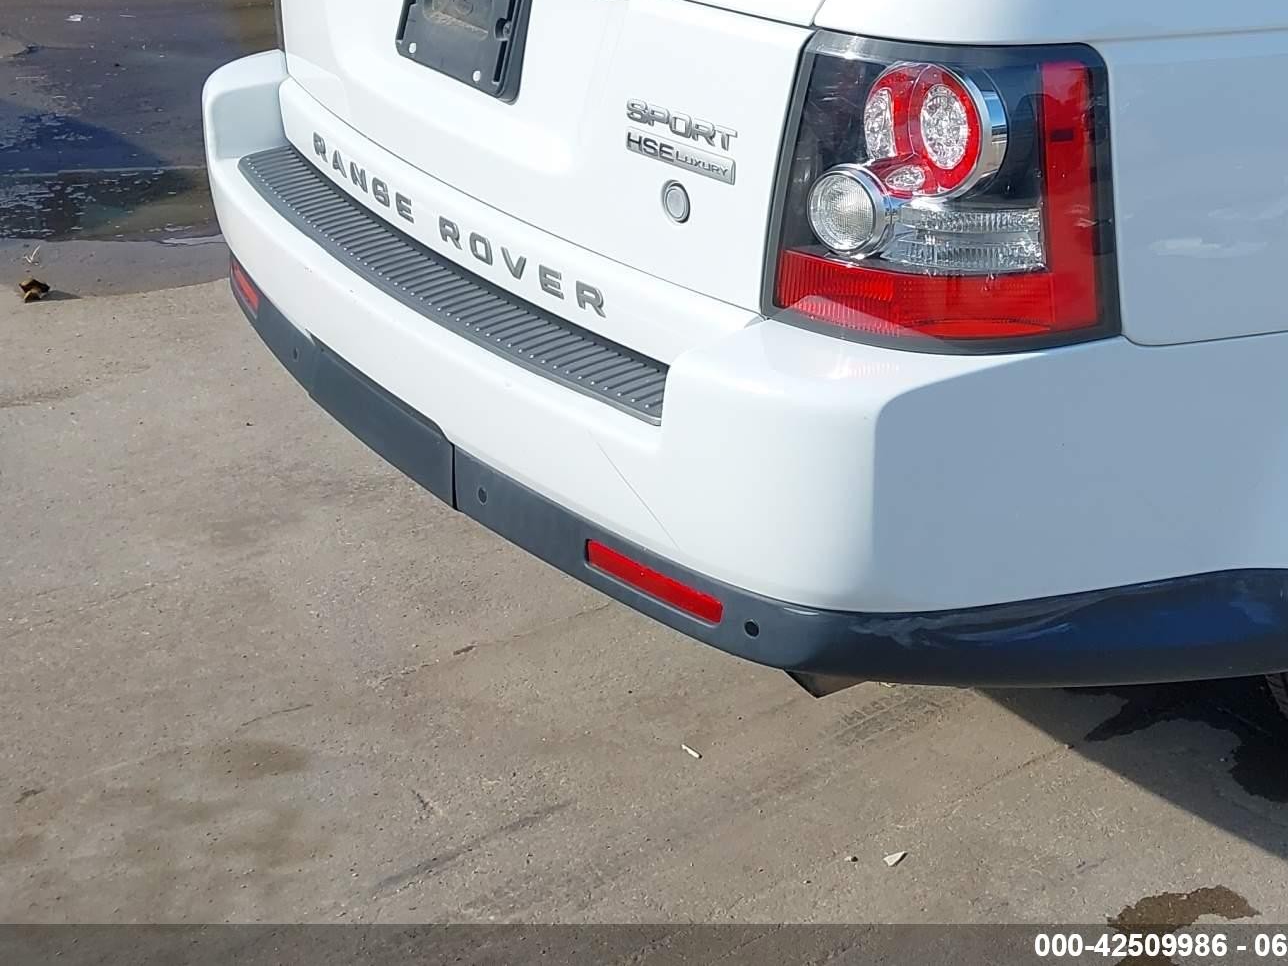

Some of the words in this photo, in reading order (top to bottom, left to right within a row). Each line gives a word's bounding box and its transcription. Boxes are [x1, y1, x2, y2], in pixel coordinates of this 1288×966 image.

[626, 98, 738, 152] SPORT
[626, 131, 675, 163] HSE
[312, 131, 415, 224] RANGE
[438, 215, 607, 319] ROVER
